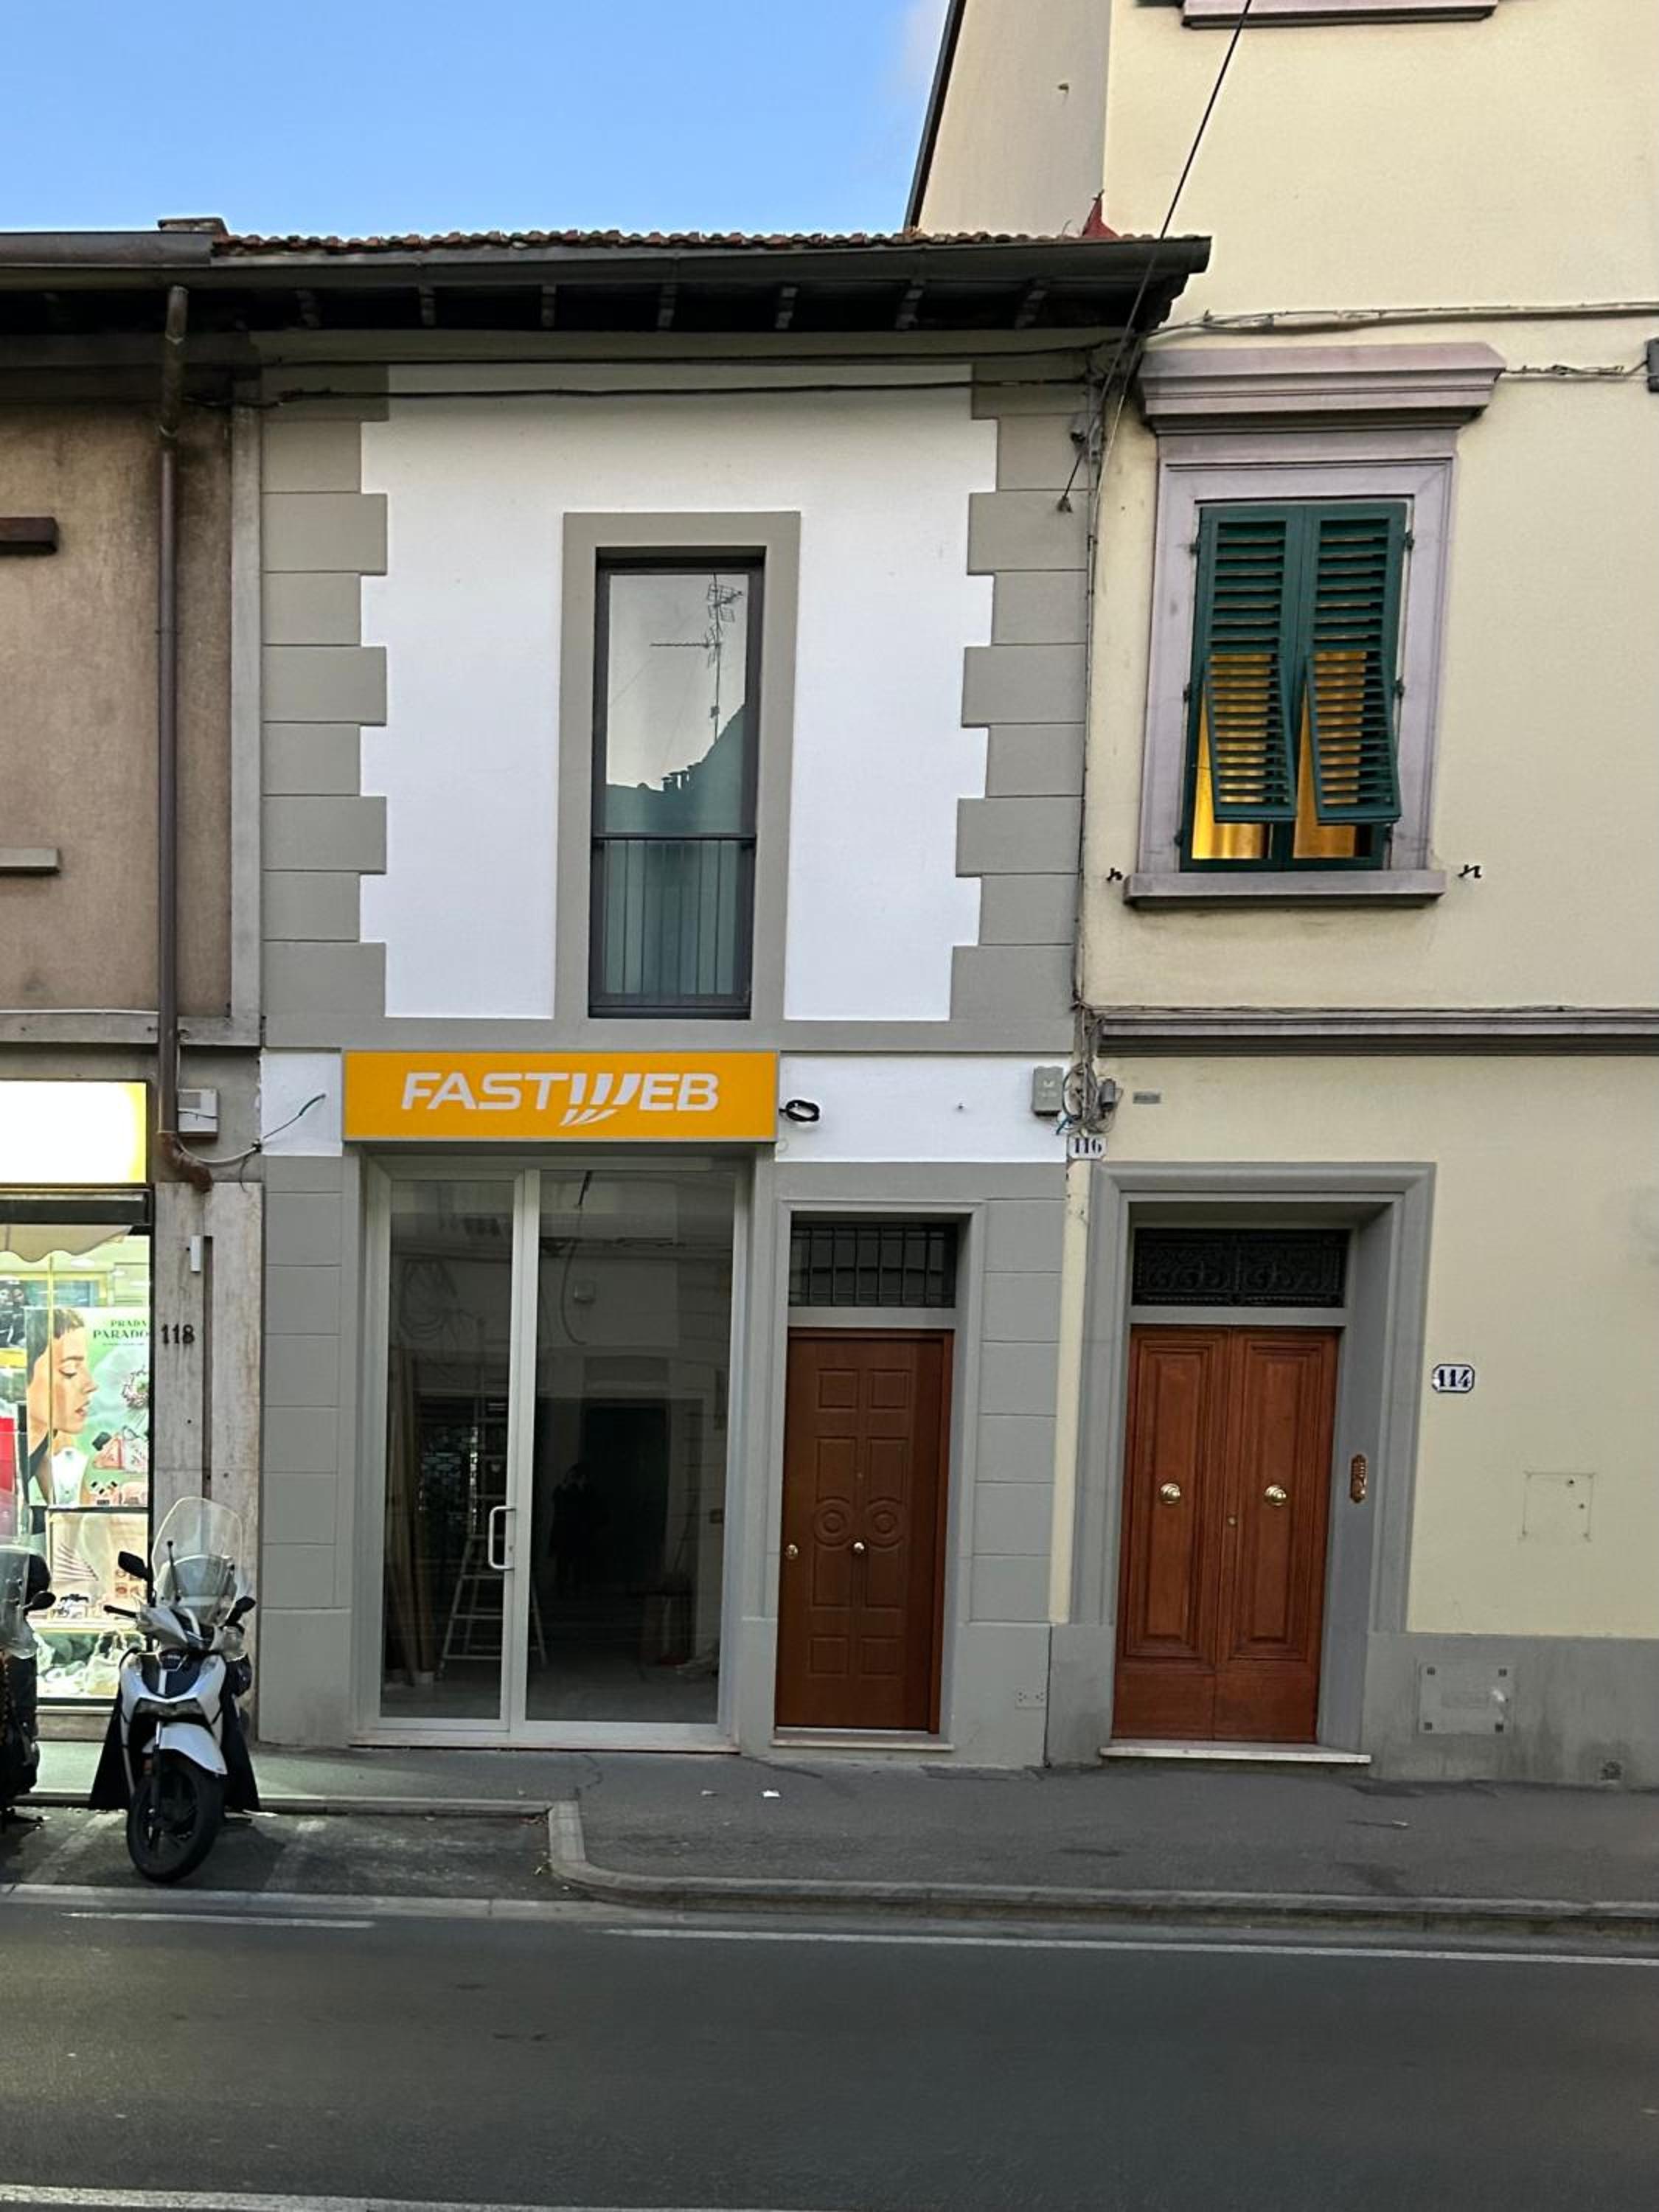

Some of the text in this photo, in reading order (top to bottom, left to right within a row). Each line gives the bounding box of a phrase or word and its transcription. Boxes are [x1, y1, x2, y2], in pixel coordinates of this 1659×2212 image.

[400, 1071, 720, 1127] FASTWEB
[1075, 1137, 1102, 1154] 116
[161, 1324, 195, 1344] 118
[1439, 1369, 1471, 1388] 114
